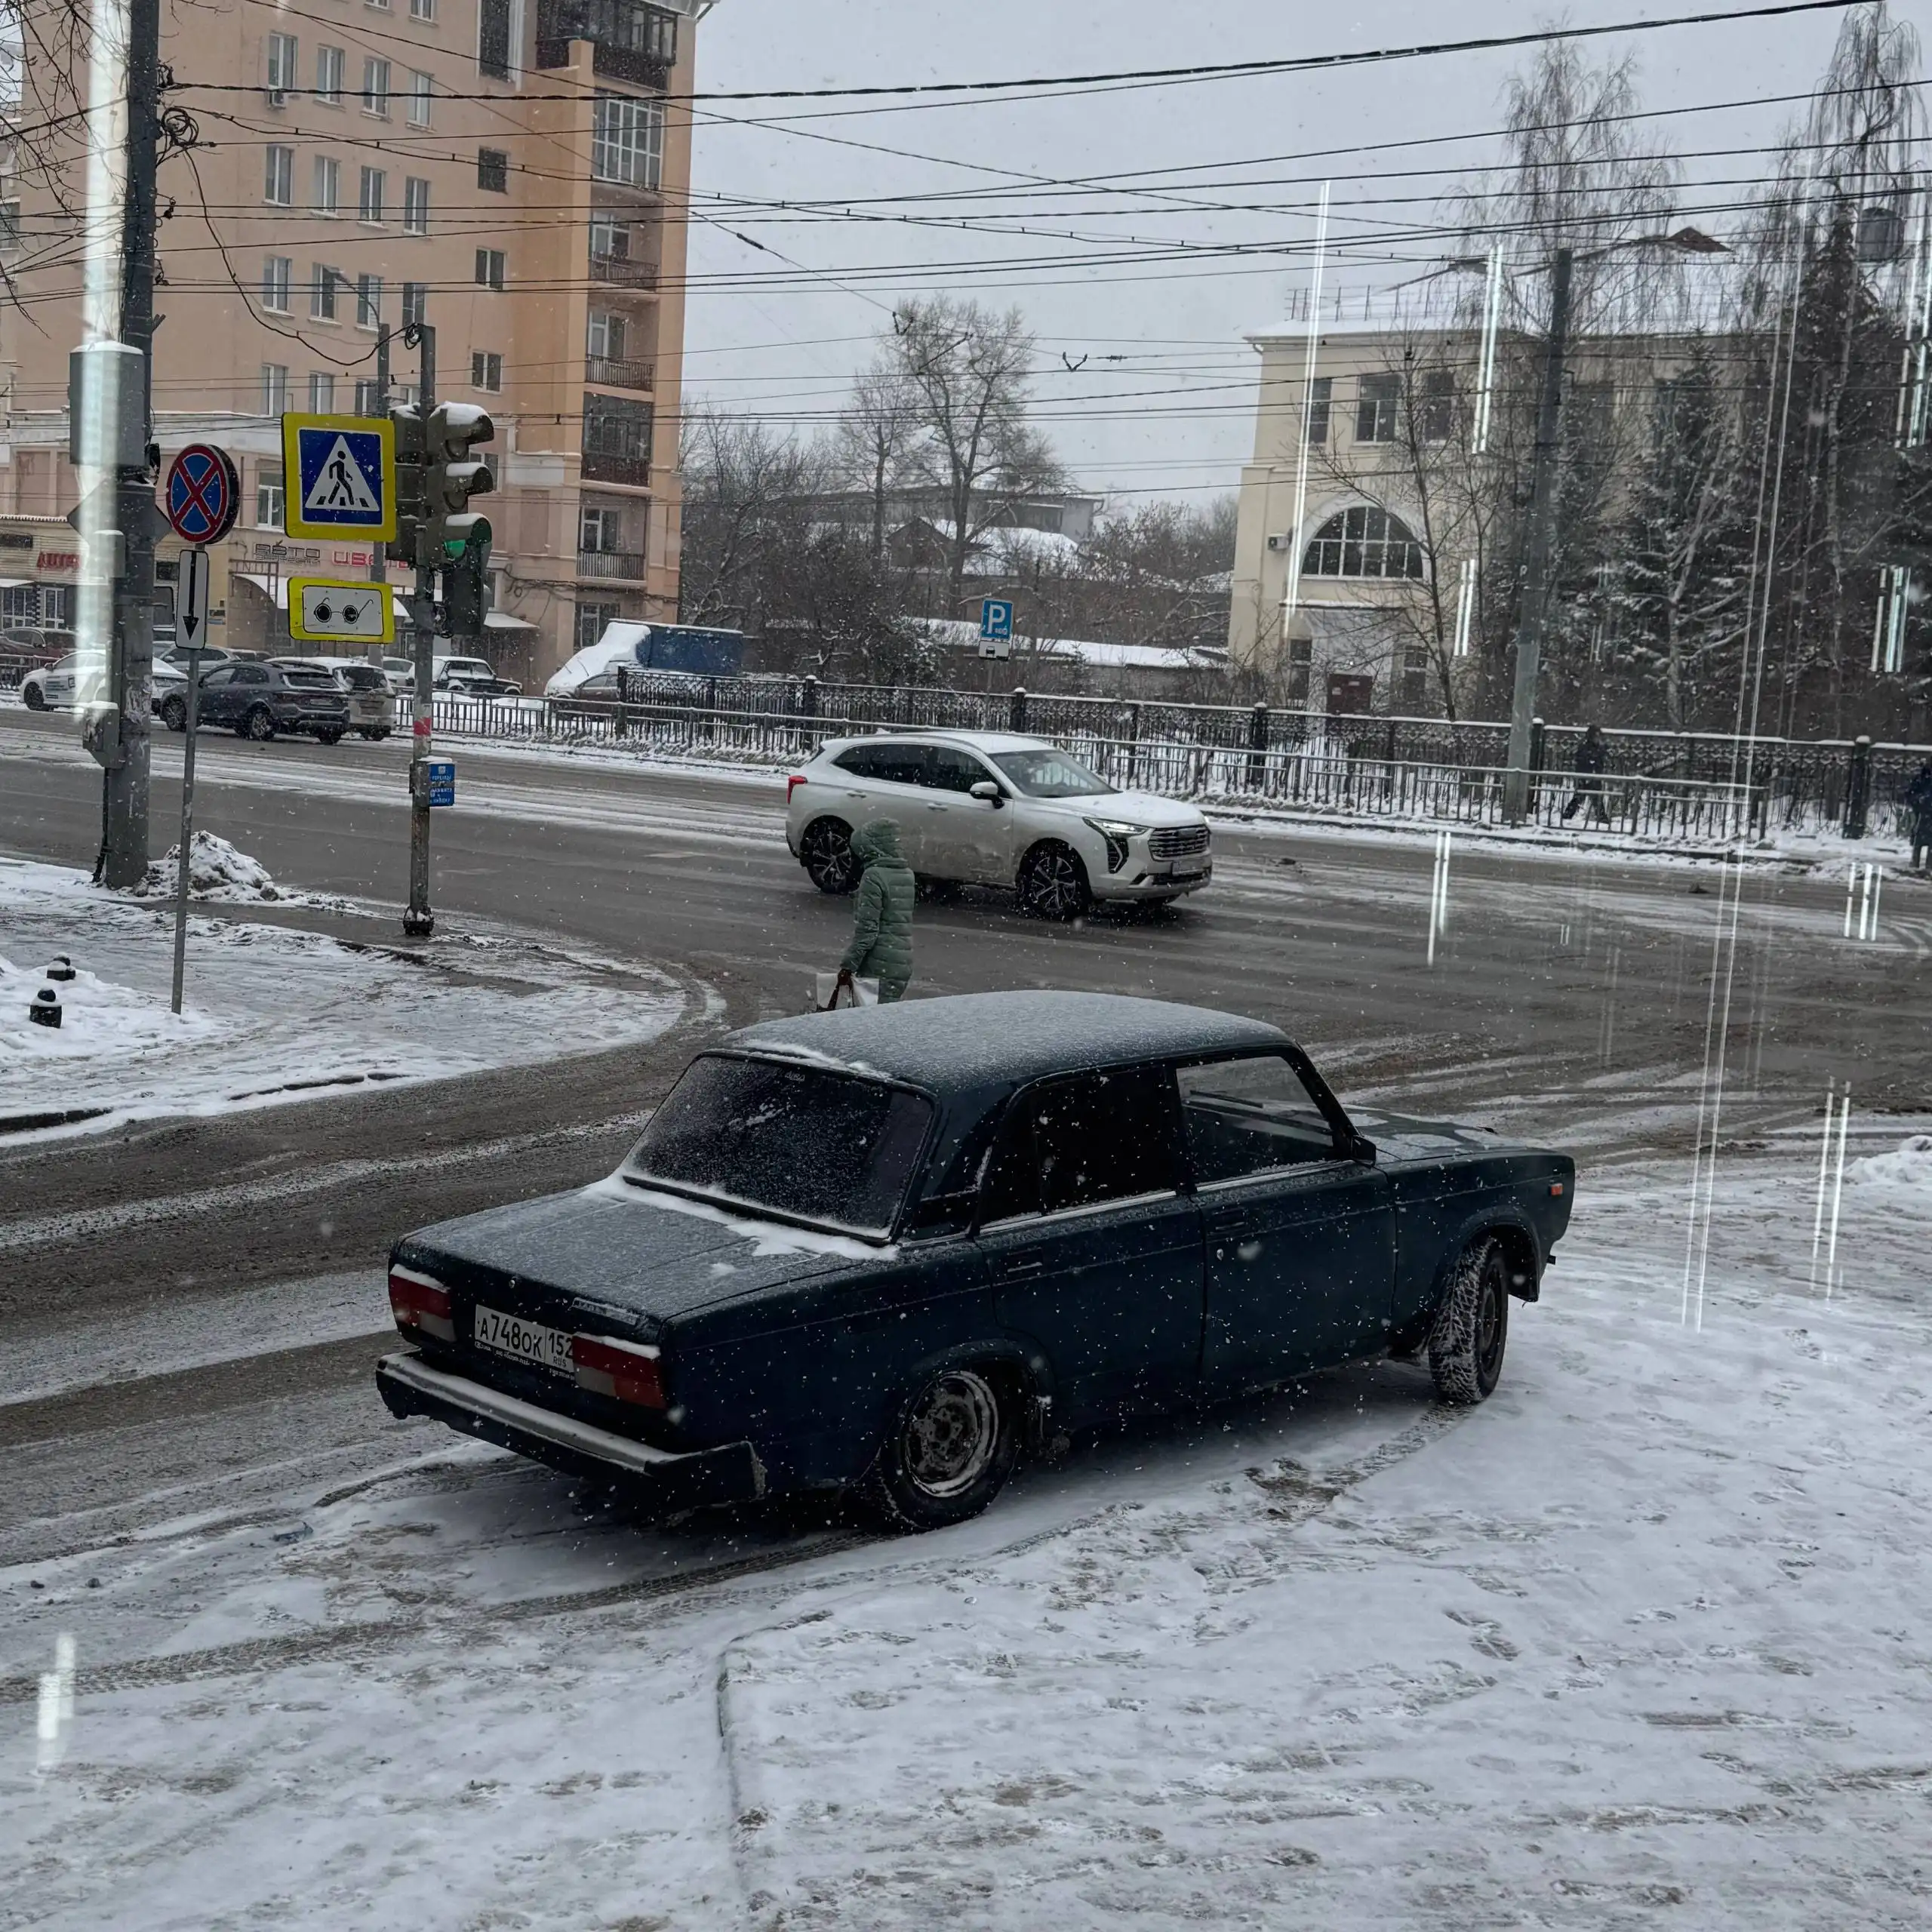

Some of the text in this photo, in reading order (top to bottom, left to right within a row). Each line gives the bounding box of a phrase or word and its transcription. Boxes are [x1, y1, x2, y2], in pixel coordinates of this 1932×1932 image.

[987, 605, 1006, 634] P
[479, 1313, 543, 1359] А748ОК
[548, 1332, 573, 1358] 152
[552, 1355, 568, 1368] RUS
